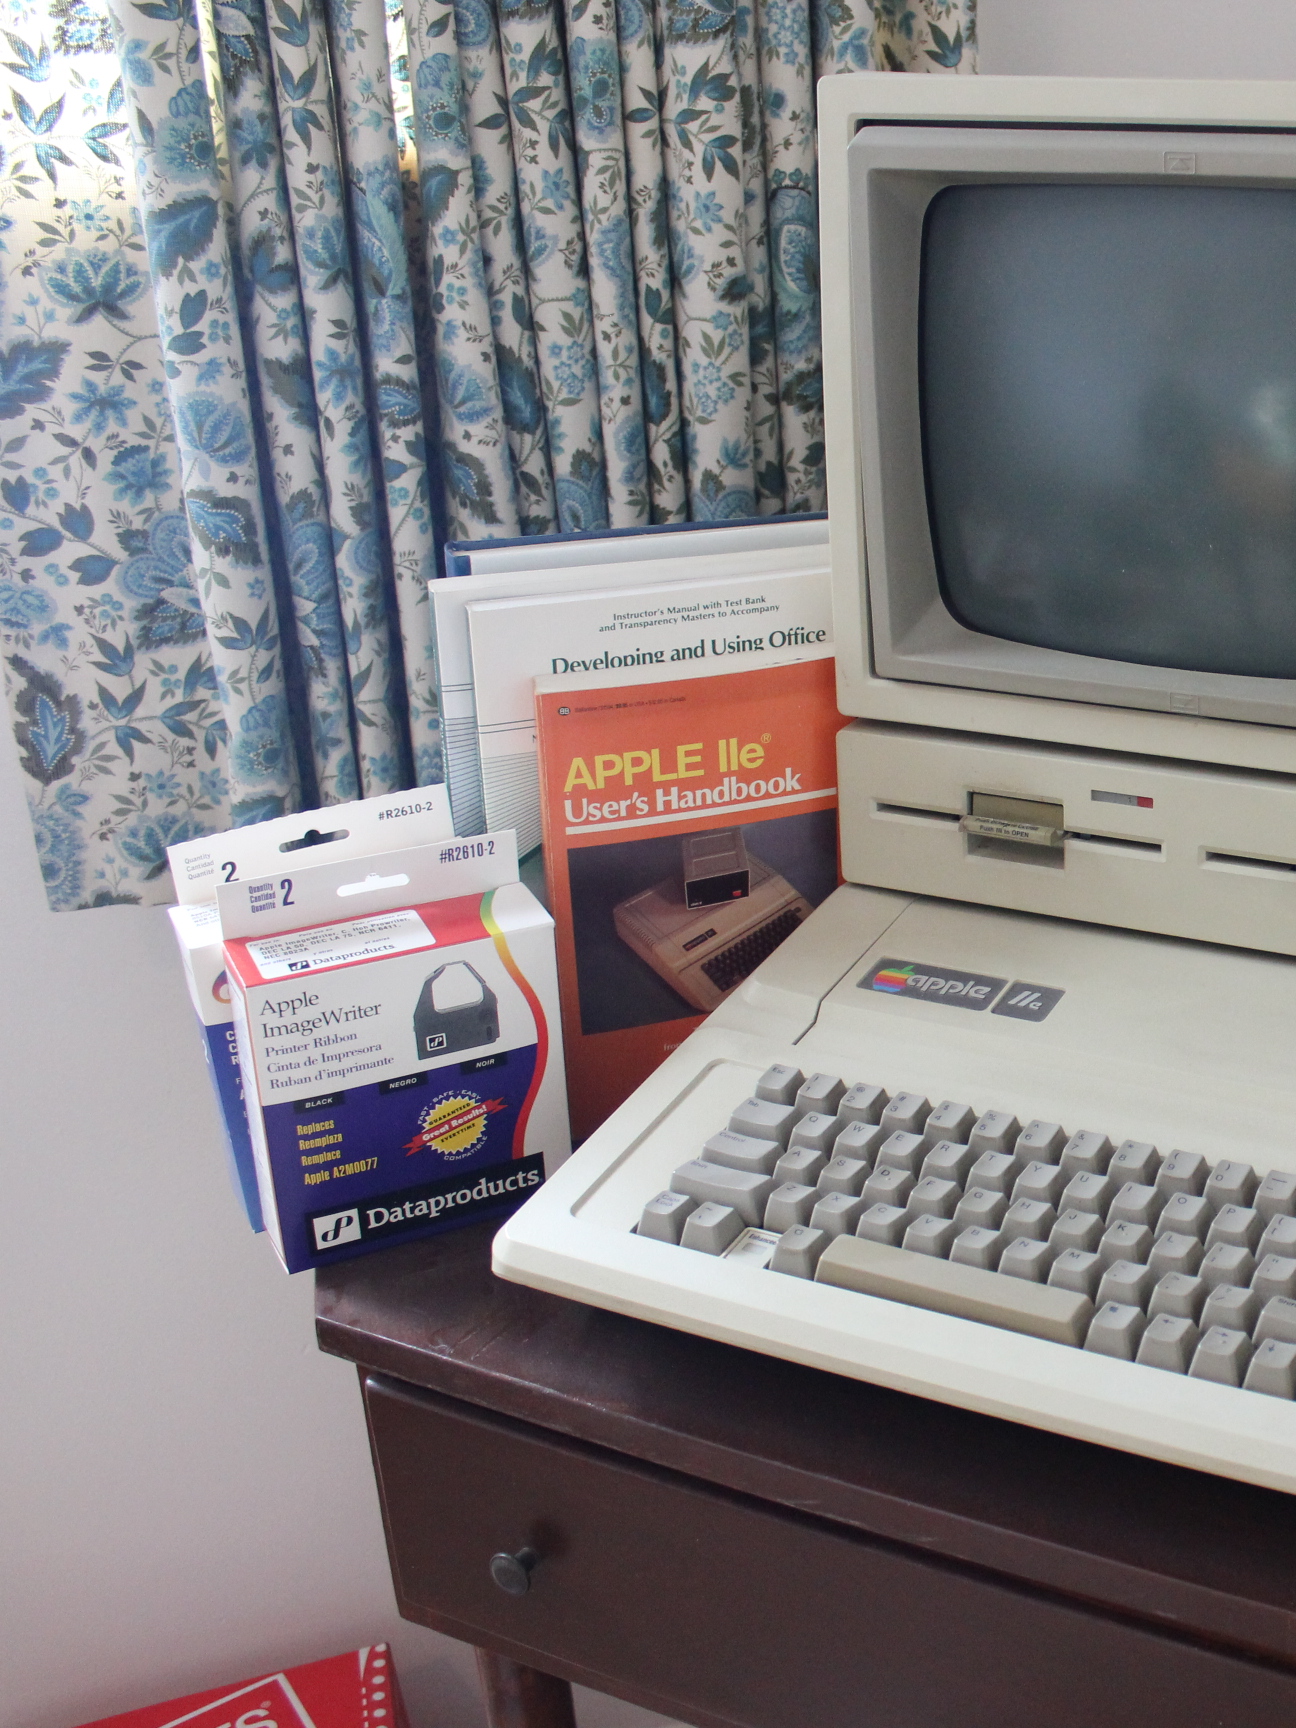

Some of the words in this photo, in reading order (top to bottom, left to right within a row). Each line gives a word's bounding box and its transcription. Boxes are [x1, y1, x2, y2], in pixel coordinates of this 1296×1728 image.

[599, 623, 616, 632] and
[619, 616, 678, 630] Transparency
[681, 611, 715, 622] Masters
[729, 604, 780, 617] Accompany
[613, 608, 664, 621] Instructor's
[667, 603, 700, 614] Manual
[703, 601, 722, 610] with
[724, 598, 742, 607] Test
[745, 595, 766, 605] Bank
[552, 648, 664, 675] Developing
[670, 639, 705, 662] and
[711, 635, 763, 656] Using
[769, 627, 826, 648] Office
[564, 743, 704, 792] APPLE
[565, 792, 649, 823] User's
[656, 767, 802, 812] Handbook
[378, 802, 433, 820] #R2610-2
[1011, 830, 1030, 838] OPEN
[185, 853, 211, 865] Quantity
[439, 841, 495, 864] #R2610-2
[186, 860, 214, 872] Cantidad
[221, 861, 239, 883] 2
[249, 883, 273, 894] Quantity
[250, 891, 276, 903] Cantidad
[280, 879, 295, 906] 2
[259, 943, 283, 952] Apple
[310, 938, 327, 946] DEC
[312, 943, 396, 966] Dataproducts
[906, 974, 991, 999] apple
[259, 992, 319, 1018] Apple
[261, 1003, 382, 1038] ImageWriter
[264, 1043, 310, 1058] Printer
[313, 1032, 358, 1049] Ribbon
[267, 1060, 300, 1074] Cinta
[304, 1056, 319, 1067] de
[321, 1043, 382, 1065] Impresora
[475, 1058, 495, 1068] NOIR
[270, 1074, 311, 1090] Ruban
[314, 1057, 395, 1081] d'imprimante
[772, 1066, 786, 1075] Esc
[389, 1077, 418, 1090] NEGRO
[305, 1097, 333, 1109] BLACK
[418, 1106, 429, 1125] FAST
[432, 1090, 454, 1103] SAFE
[461, 1089, 481, 1100] EASY
[428, 1102, 471, 1126] GUARANTEED
[297, 1120, 335, 1136] Replaces
[422, 1124, 449, 1141] Great
[451, 1105, 488, 1128] Results!
[299, 1133, 343, 1150] Reemplaza
[444, 1135, 488, 1161] COMPATIBLE
[719, 1132, 747, 1143] Control
[301, 1150, 342, 1166] Remplace
[304, 1170, 330, 1186] Apple
[333, 1157, 378, 1179] A2M0077
[366, 1169, 540, 1229] Dataproducts
